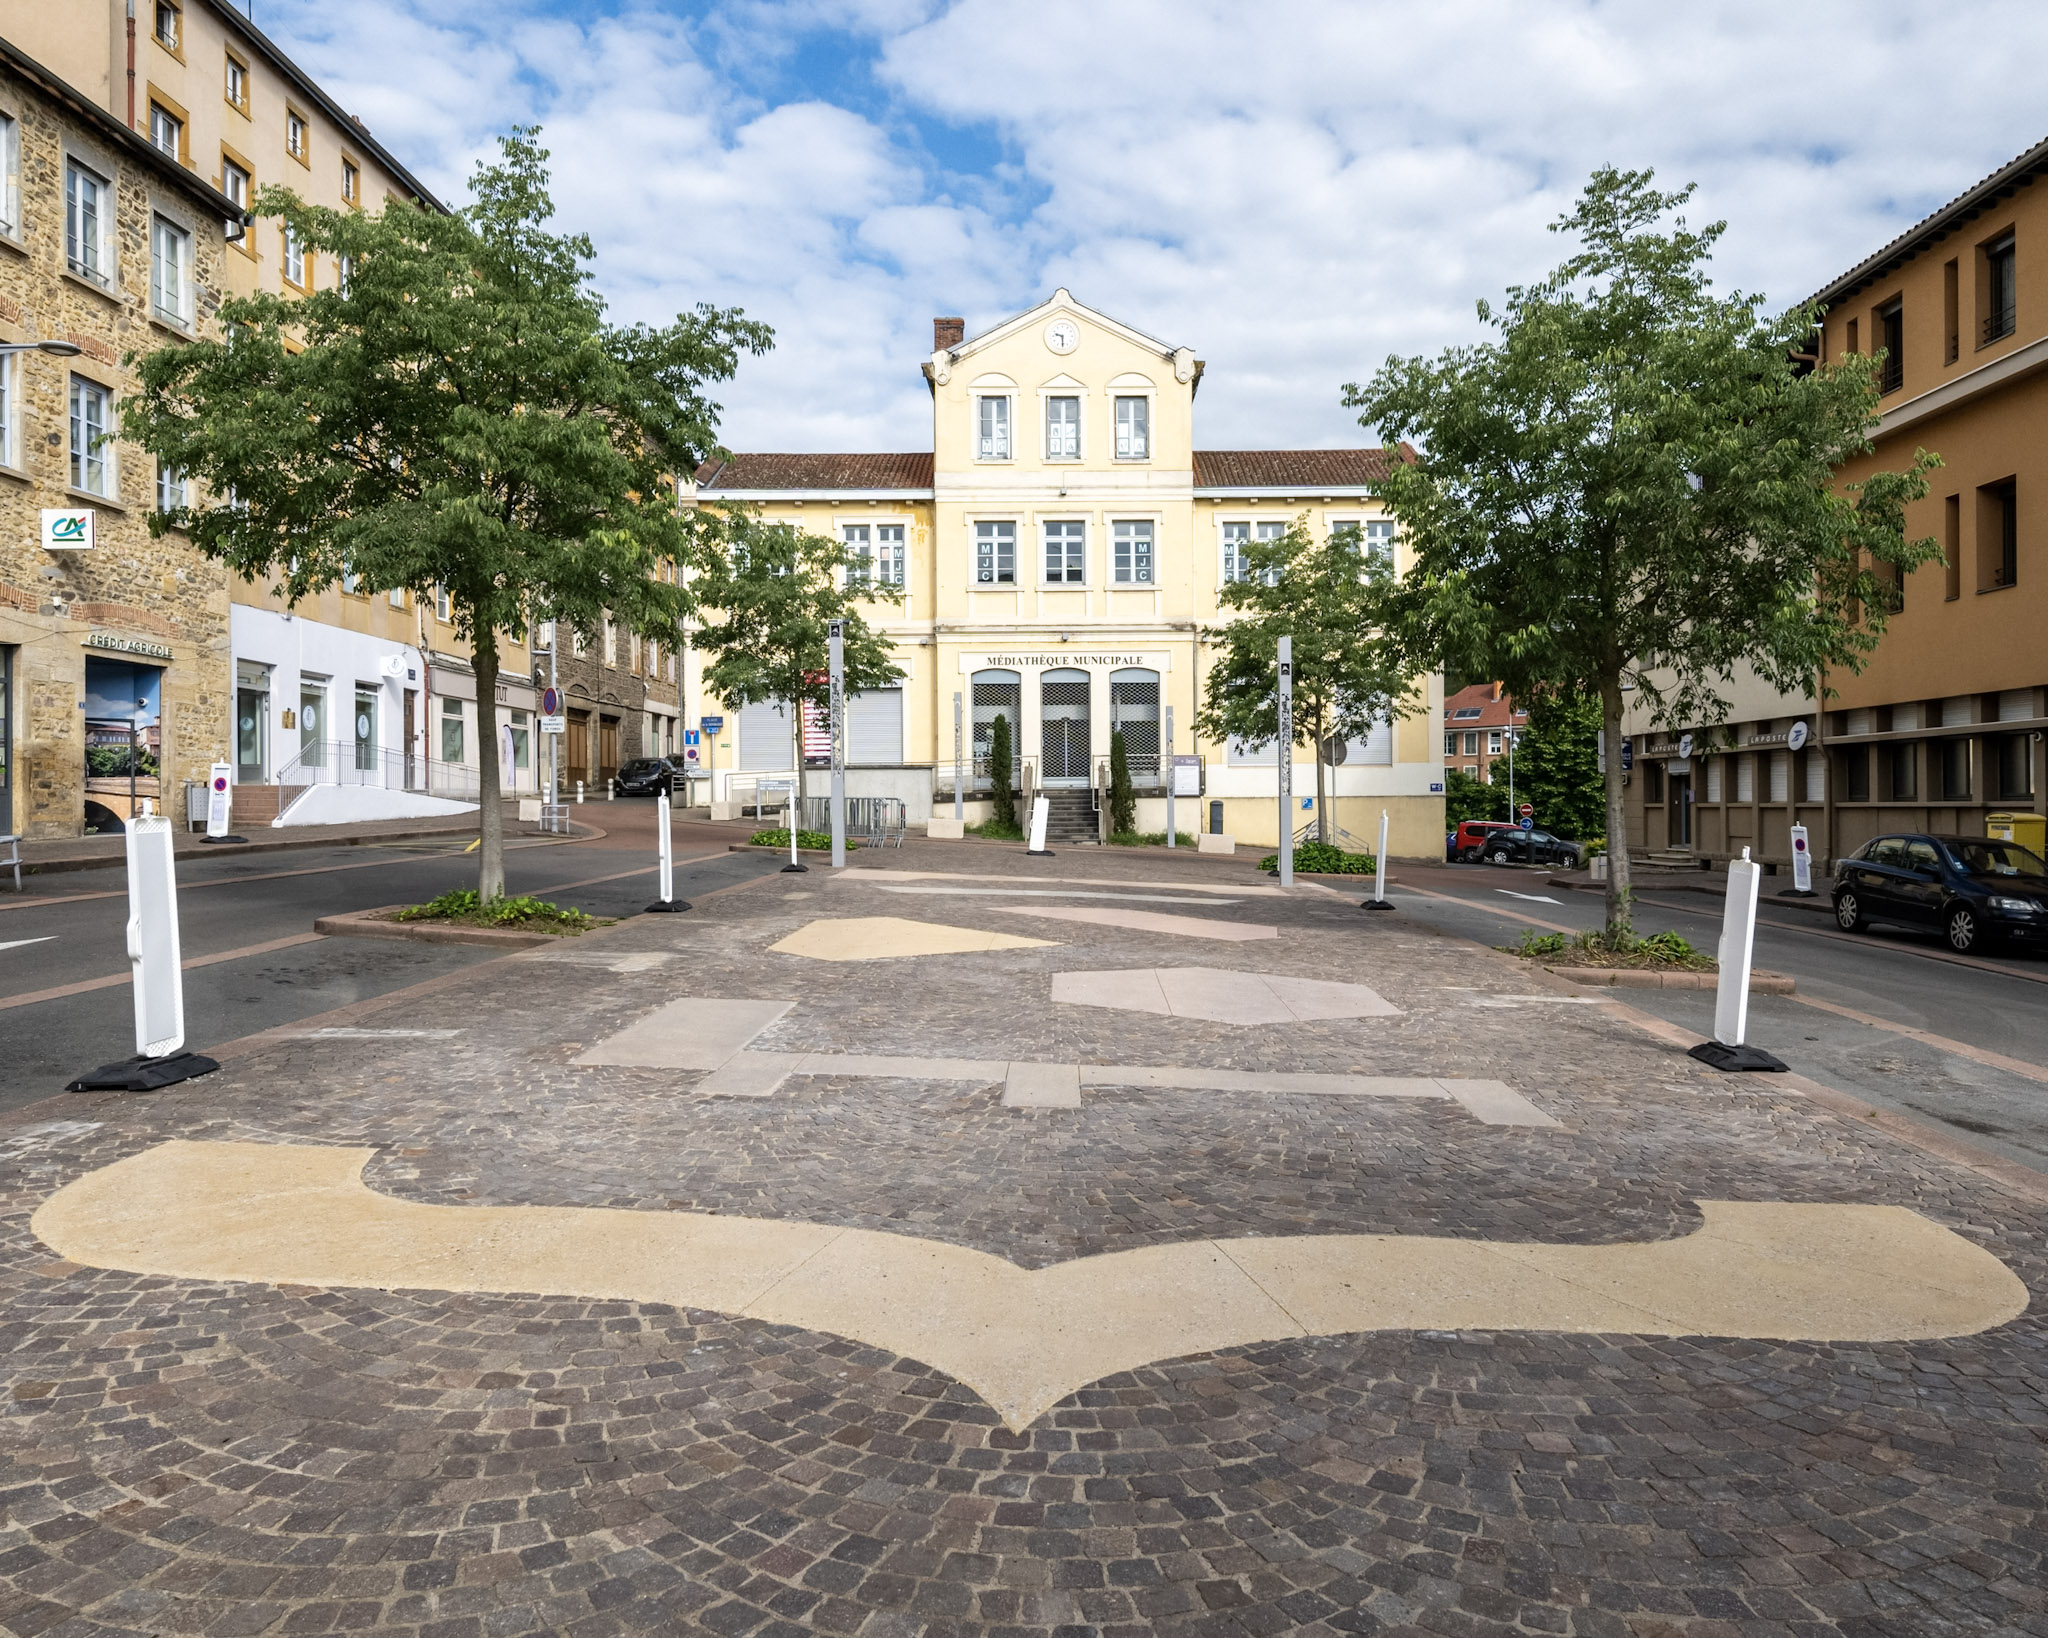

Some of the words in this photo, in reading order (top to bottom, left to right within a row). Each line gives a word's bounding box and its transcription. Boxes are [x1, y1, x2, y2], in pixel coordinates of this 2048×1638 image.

[894, 549, 903, 584] MJC
[981, 544, 990, 580] MJC
[1138, 543, 1148, 580] MJC
[88, 634, 125, 649] CRÉDIT
[126, 641, 173, 657] AGRICOLE
[987, 654, 1069, 667] MÉDIATHÈQUE
[1073, 656, 1143, 665] MUNICIPALE
